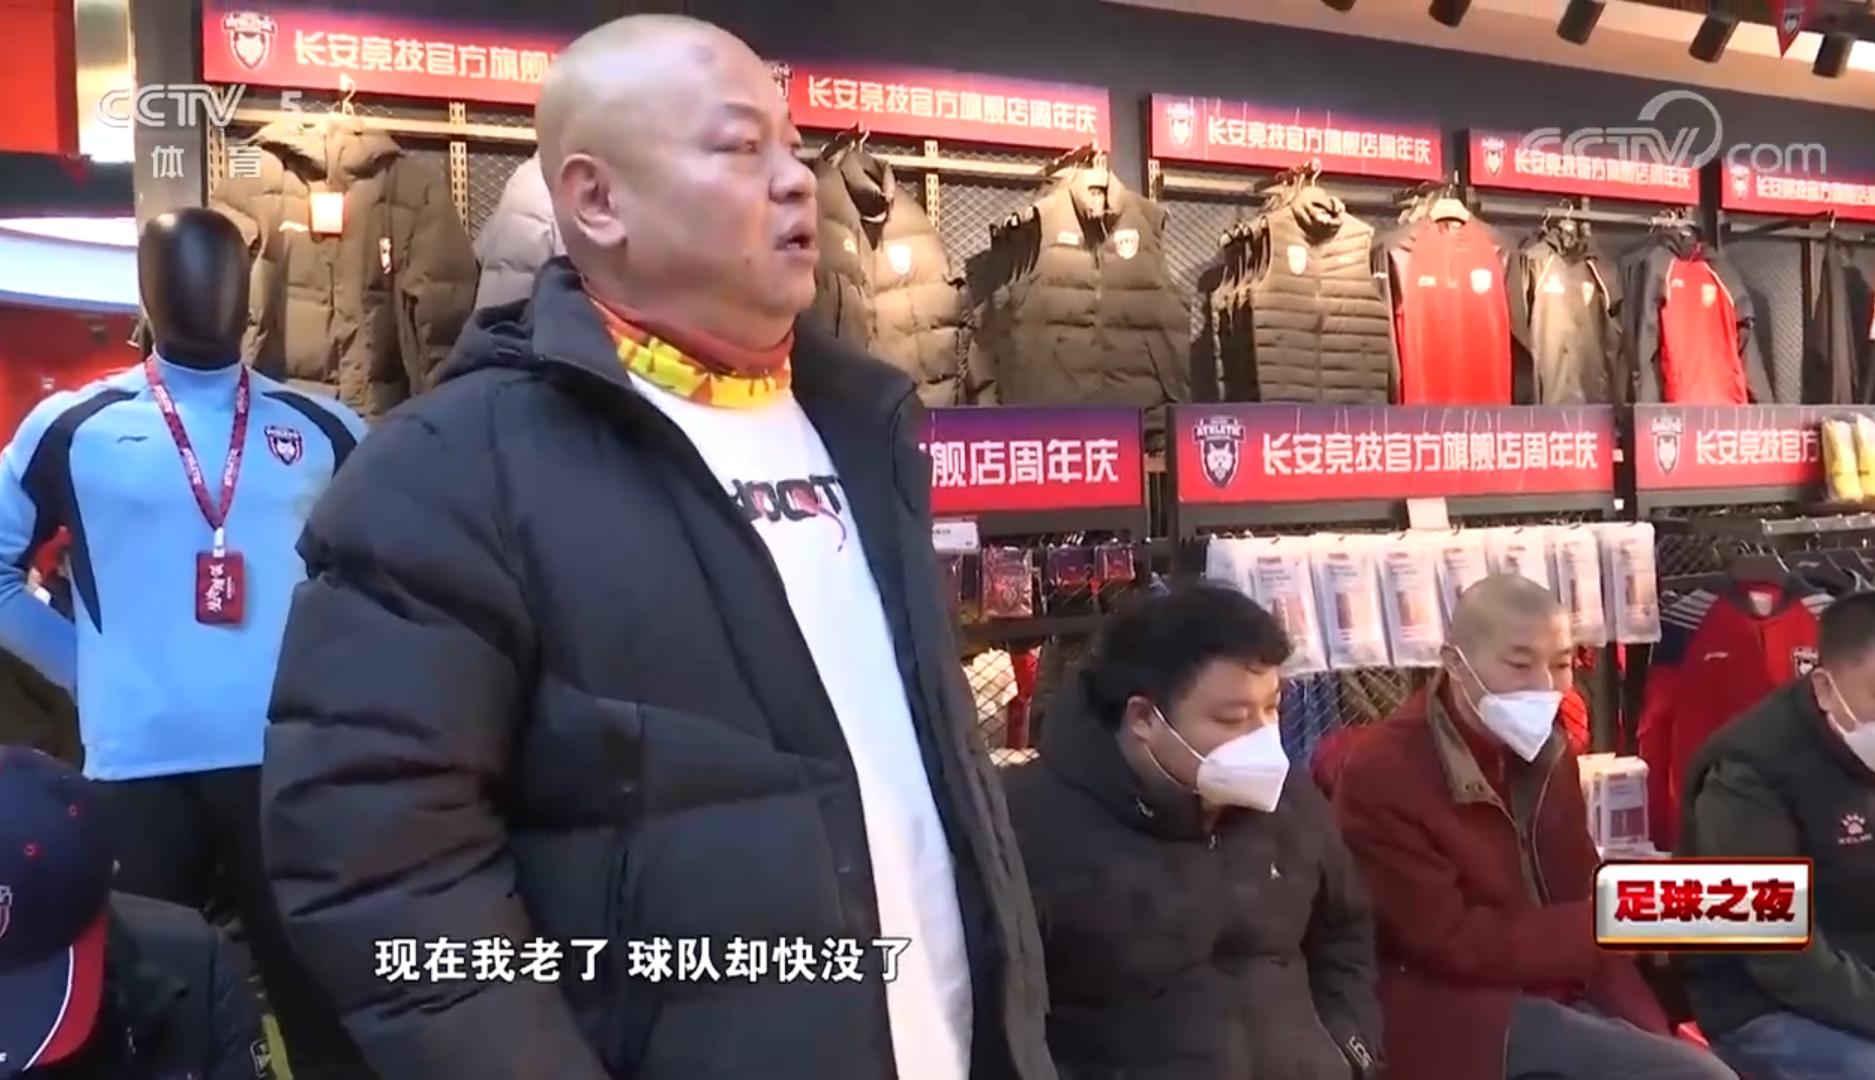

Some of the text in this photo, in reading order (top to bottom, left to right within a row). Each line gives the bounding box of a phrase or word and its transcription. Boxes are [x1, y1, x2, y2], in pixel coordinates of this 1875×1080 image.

[293, 29, 557, 83] 长安竞技官方旗舰
[807, 74, 1098, 134] 长安竞技官方旗舰店周年庆
[1207, 115, 1432, 165] 长安竞技官方旗舰店周年庆
[918, 439, 1119, 488] 舰店周年庆
[1262, 431, 1599, 476] 长安竞技官方旗舰店周年庆
